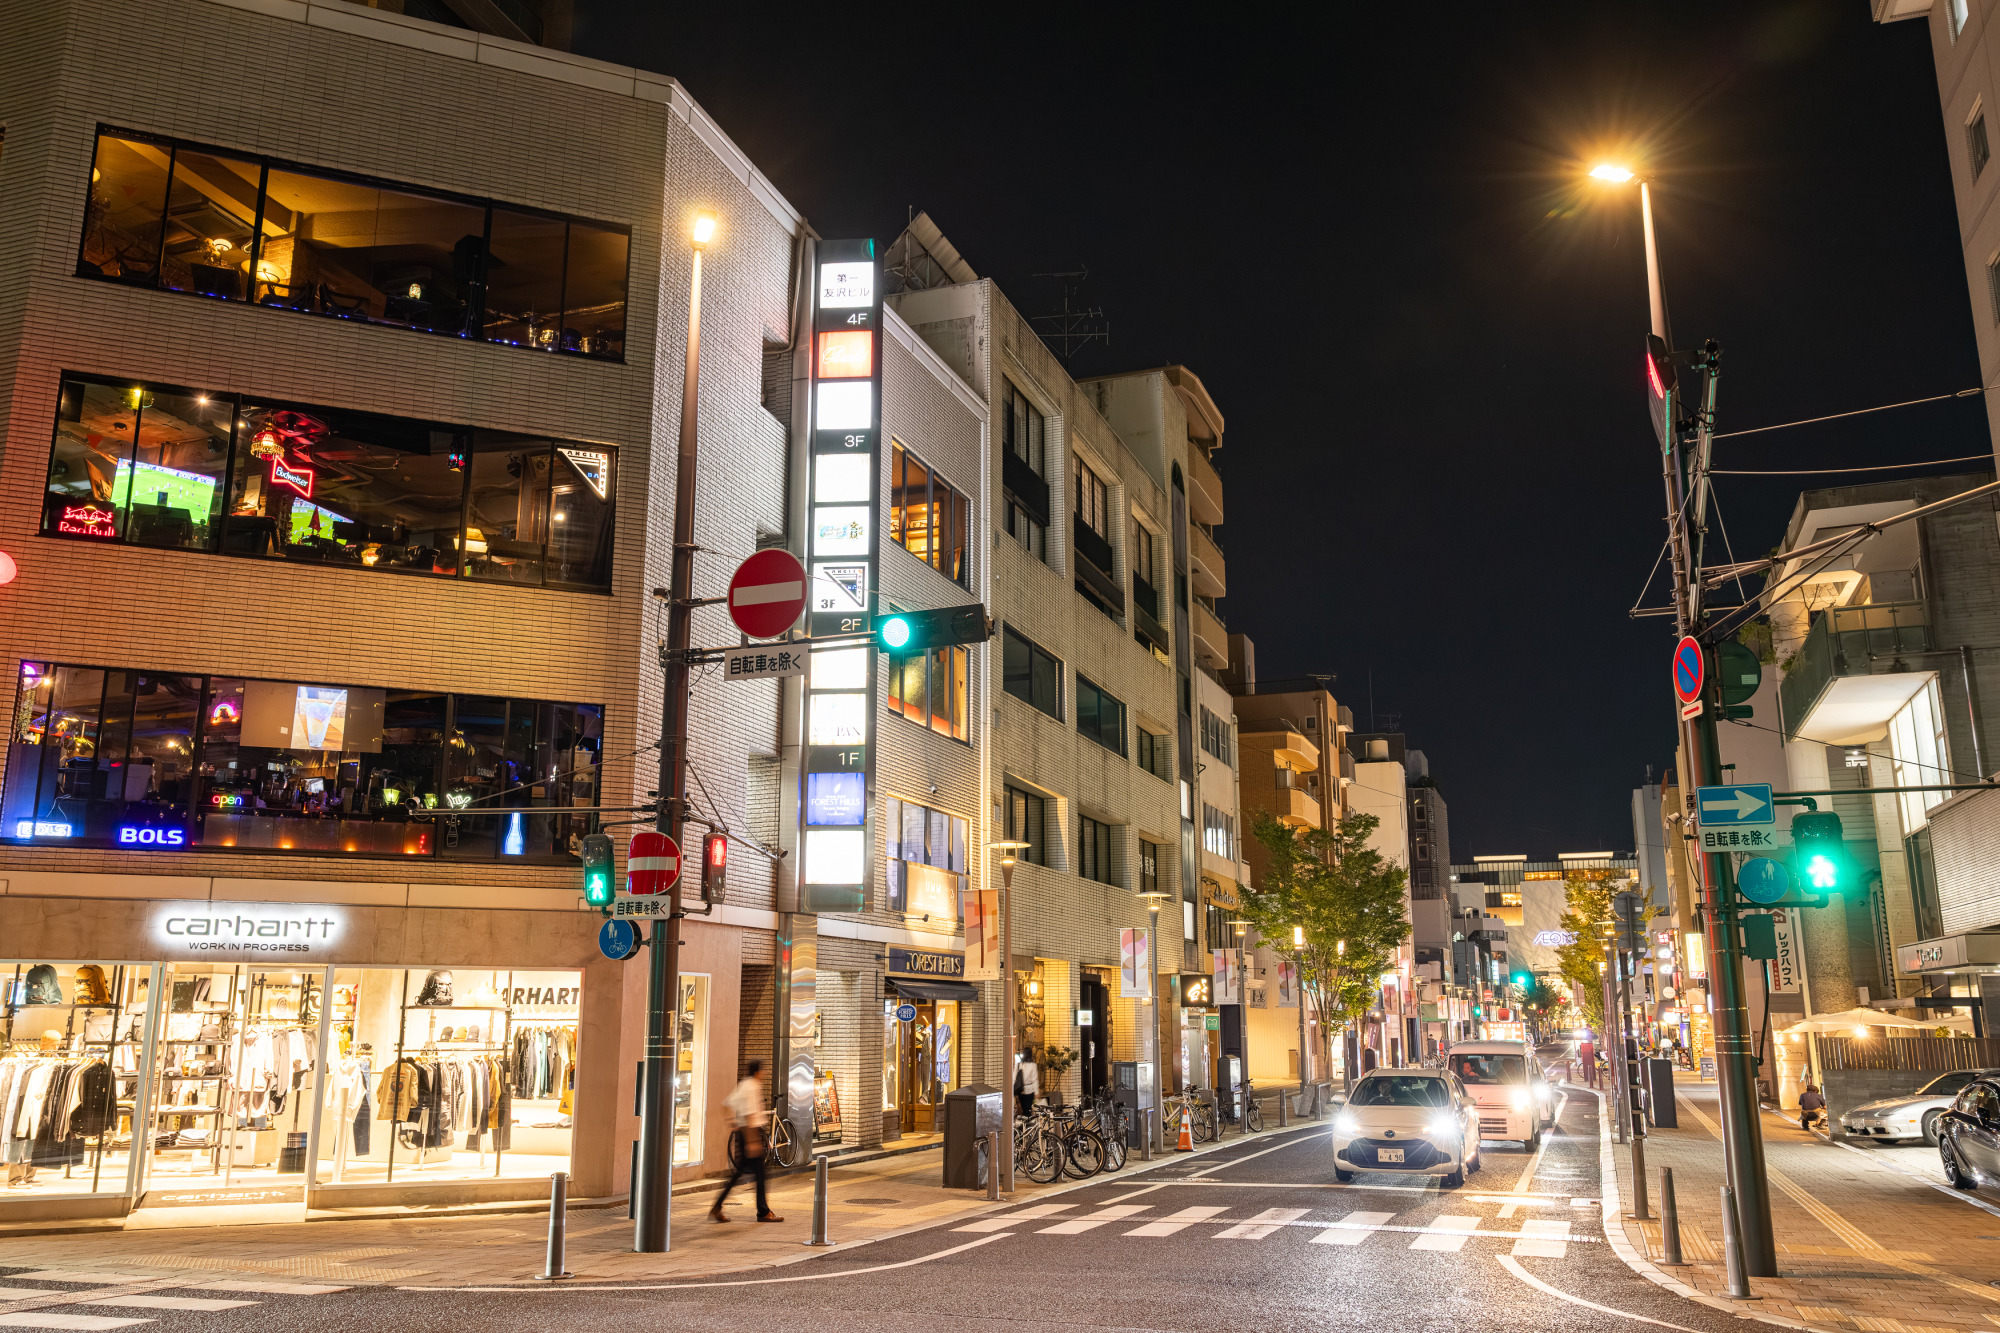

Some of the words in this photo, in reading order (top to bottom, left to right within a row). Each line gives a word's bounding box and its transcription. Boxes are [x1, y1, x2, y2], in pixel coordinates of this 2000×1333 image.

[837, 273, 859, 283] 第一
[823, 287, 870, 298] 友沢ビル
[847, 313, 867, 325] 4F
[844, 434, 865, 447] 3F
[275, 466, 309, 487] Budweiser
[59, 521, 86, 533] Red
[88, 526, 115, 537] Bull
[821, 599, 836, 609] 3F
[841, 618, 862, 631] 2F
[730, 651, 801, 675] 自転車を除く
[838, 752, 860, 765] 1F
[212, 795, 243, 808] open
[811, 798, 838, 806] FOREST
[120, 827, 184, 845] BOLS
[1705, 830, 1773, 847] 自転車を除く
[617, 901, 667, 915] 自転車を除く
[166, 915, 335, 938] carhartt
[189, 942, 226, 950] WORK
[1778, 931, 1793, 986] レックハウス
